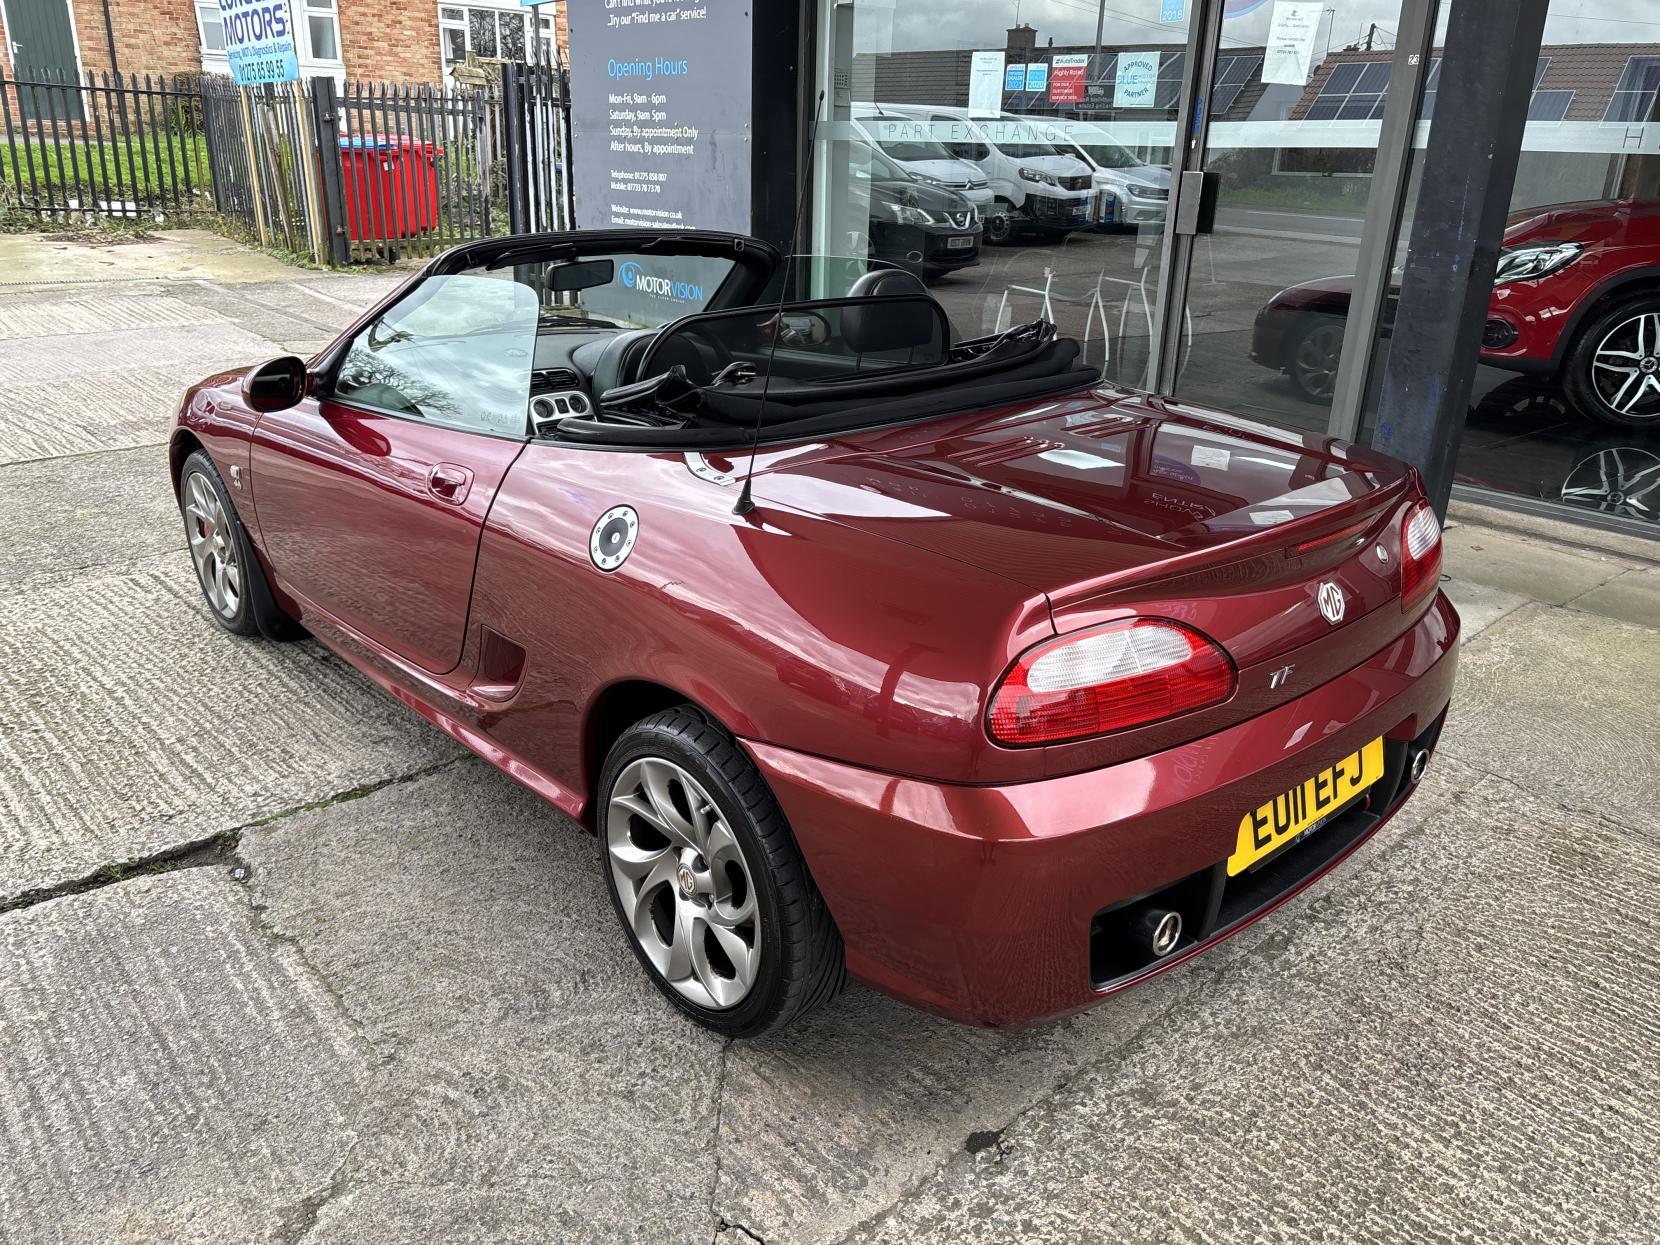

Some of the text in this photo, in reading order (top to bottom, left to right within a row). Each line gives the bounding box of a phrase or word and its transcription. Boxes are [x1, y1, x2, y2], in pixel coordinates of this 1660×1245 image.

[621, 15, 631, 24] our
[649, 13, 660, 22] me
[661, 13, 665, 21] a
[680, 6, 707, 20] service!
[1163, 9, 1182, 20] 2018
[223, 3, 286, 46] MOTORS
[1123, 61, 1153, 72] APPROVED
[1408, 54, 1419, 65] 23
[239, 62, 257, 81] 01275
[257, 61, 265, 80] 85
[276, 59, 285, 78] 55
[607, 57, 688, 80] Opening Hours
[1055, 69, 1069, 77] Highly
[1117, 74, 1138, 84] BLUE
[609, 93, 633, 105] Mon-Fri,
[633, 93, 647, 103] 9am
[651, 93, 666, 106] 6pm
[1124, 88, 1149, 98] PARTNER
[609, 109, 666, 122] Saturday, 9am 5pm
[633, 125, 641, 139] By
[642, 126, 682, 139] appointment
[682, 126, 698, 140] Only
[889, 124, 1074, 142] PART EXCHANGE
[610, 140, 624, 151] After
[644, 142, 652, 155] By
[652, 143, 694, 155] appointment
[634, 172, 648, 180] 01275
[636, 274, 703, 302] MOTORVISION
[1320, 584, 1343, 620] MG
[1270, 664, 1295, 689] TF
[1250, 784, 1307, 851] EU11
[1314, 749, 1363, 812] EFJ
[680, 869, 694, 891] MG
